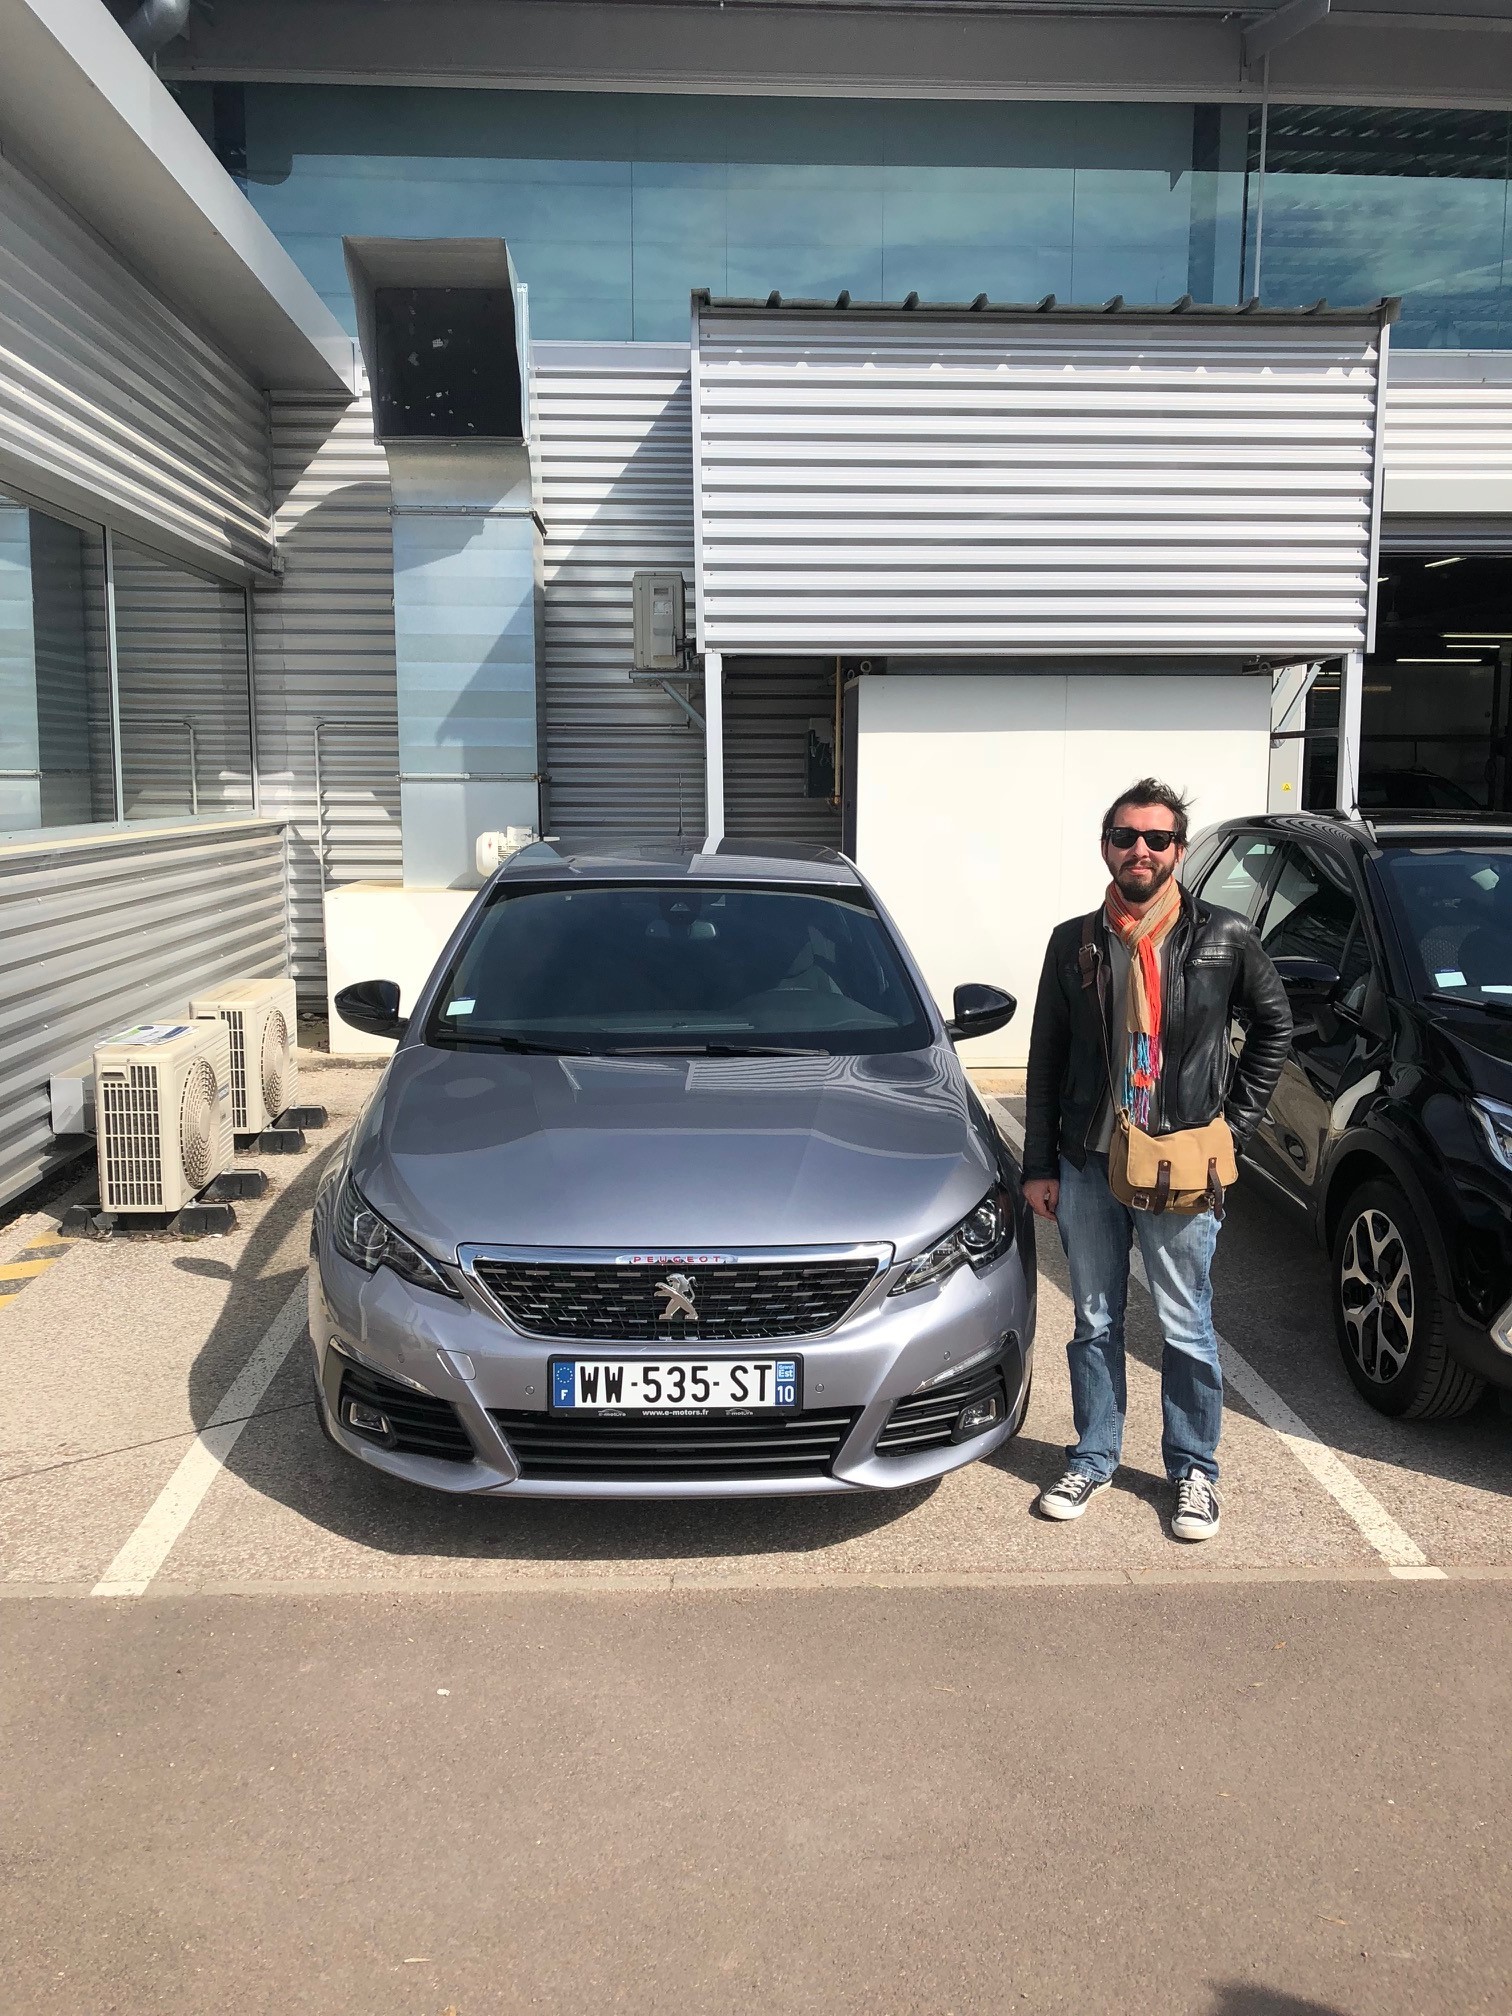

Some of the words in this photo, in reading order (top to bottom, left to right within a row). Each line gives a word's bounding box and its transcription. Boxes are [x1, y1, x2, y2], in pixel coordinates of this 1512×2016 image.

[633, 1256, 722, 1264] PEUGEOT
[778, 1369, 794, 1378] Est
[579, 1364, 773, 1404] WW-535-ST
[560, 1389, 569, 1401] F
[777, 1385, 795, 1403] 10
